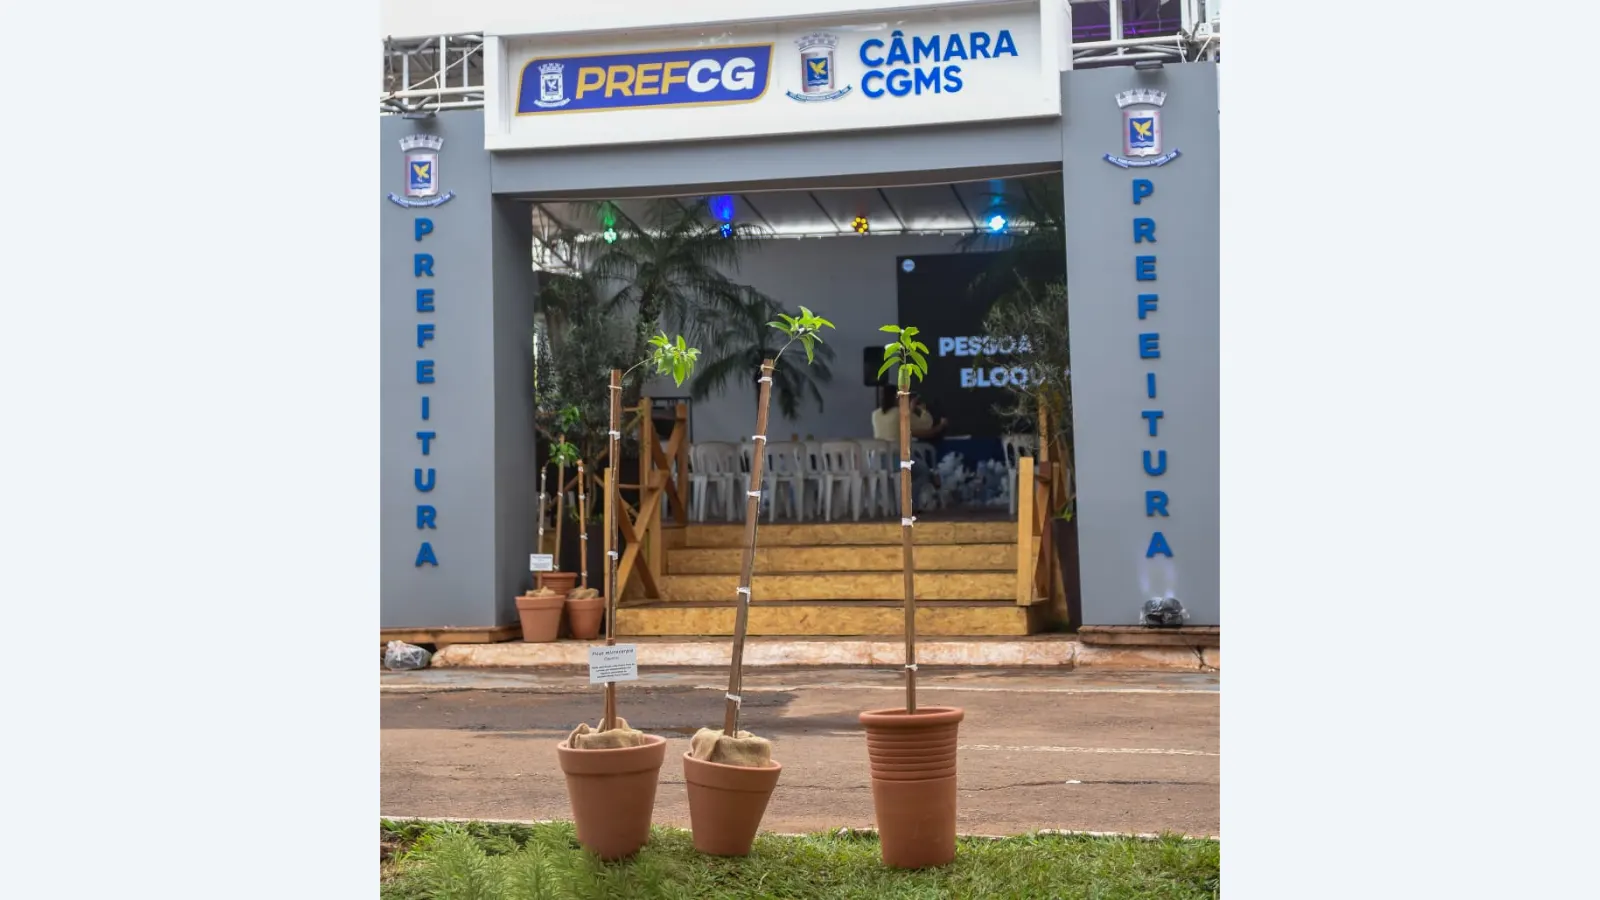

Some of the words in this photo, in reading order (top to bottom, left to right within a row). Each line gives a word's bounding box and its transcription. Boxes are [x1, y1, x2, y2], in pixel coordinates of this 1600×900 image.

[859, 30, 1018, 66] CÂMARA
[576, 57, 756, 100] PREFCG
[861, 64, 963, 99] CGMS
[1131, 178, 1174, 558] PREFEITURA
[413, 216, 438, 567] PREFEITURA
